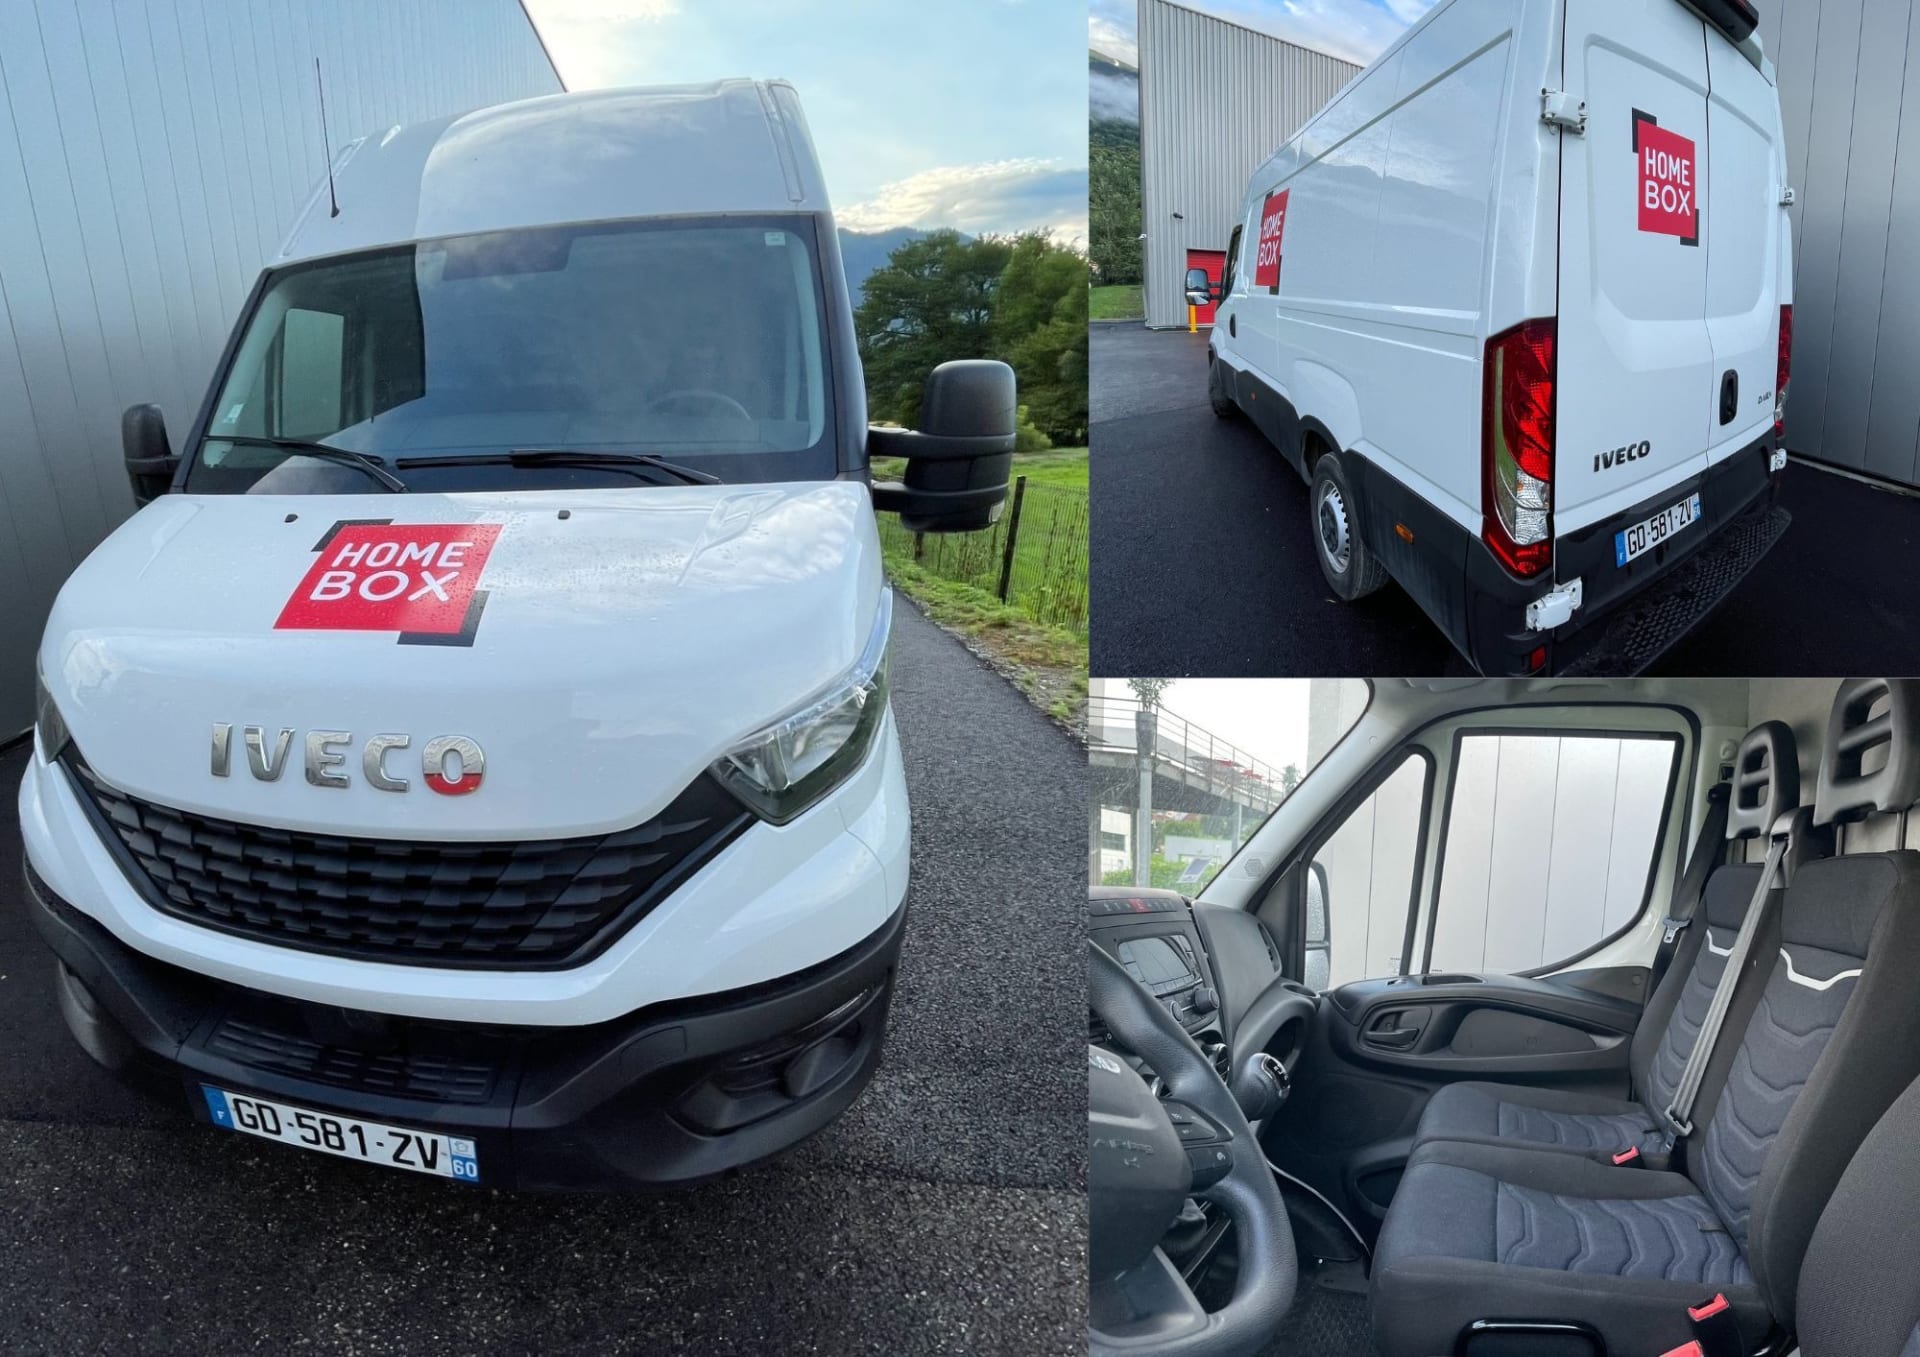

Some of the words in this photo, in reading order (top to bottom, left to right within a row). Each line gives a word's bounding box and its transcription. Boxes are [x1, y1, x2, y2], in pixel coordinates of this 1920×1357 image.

[1645, 146, 1691, 187] HOME
[1645, 179, 1691, 217] BOX
[1262, 210, 1284, 240] HOME
[1258, 240, 1280, 267] BOX
[1593, 440, 1651, 472] IVECO
[1627, 498, 1692, 556] GD-581-ZV
[331, 541, 474, 568] HOME
[309, 570, 459, 602] BOX
[211, 722, 486, 796] IVECO
[232, 1098, 438, 1170] GD-581-ZV
[453, 1159, 478, 1178] 60
